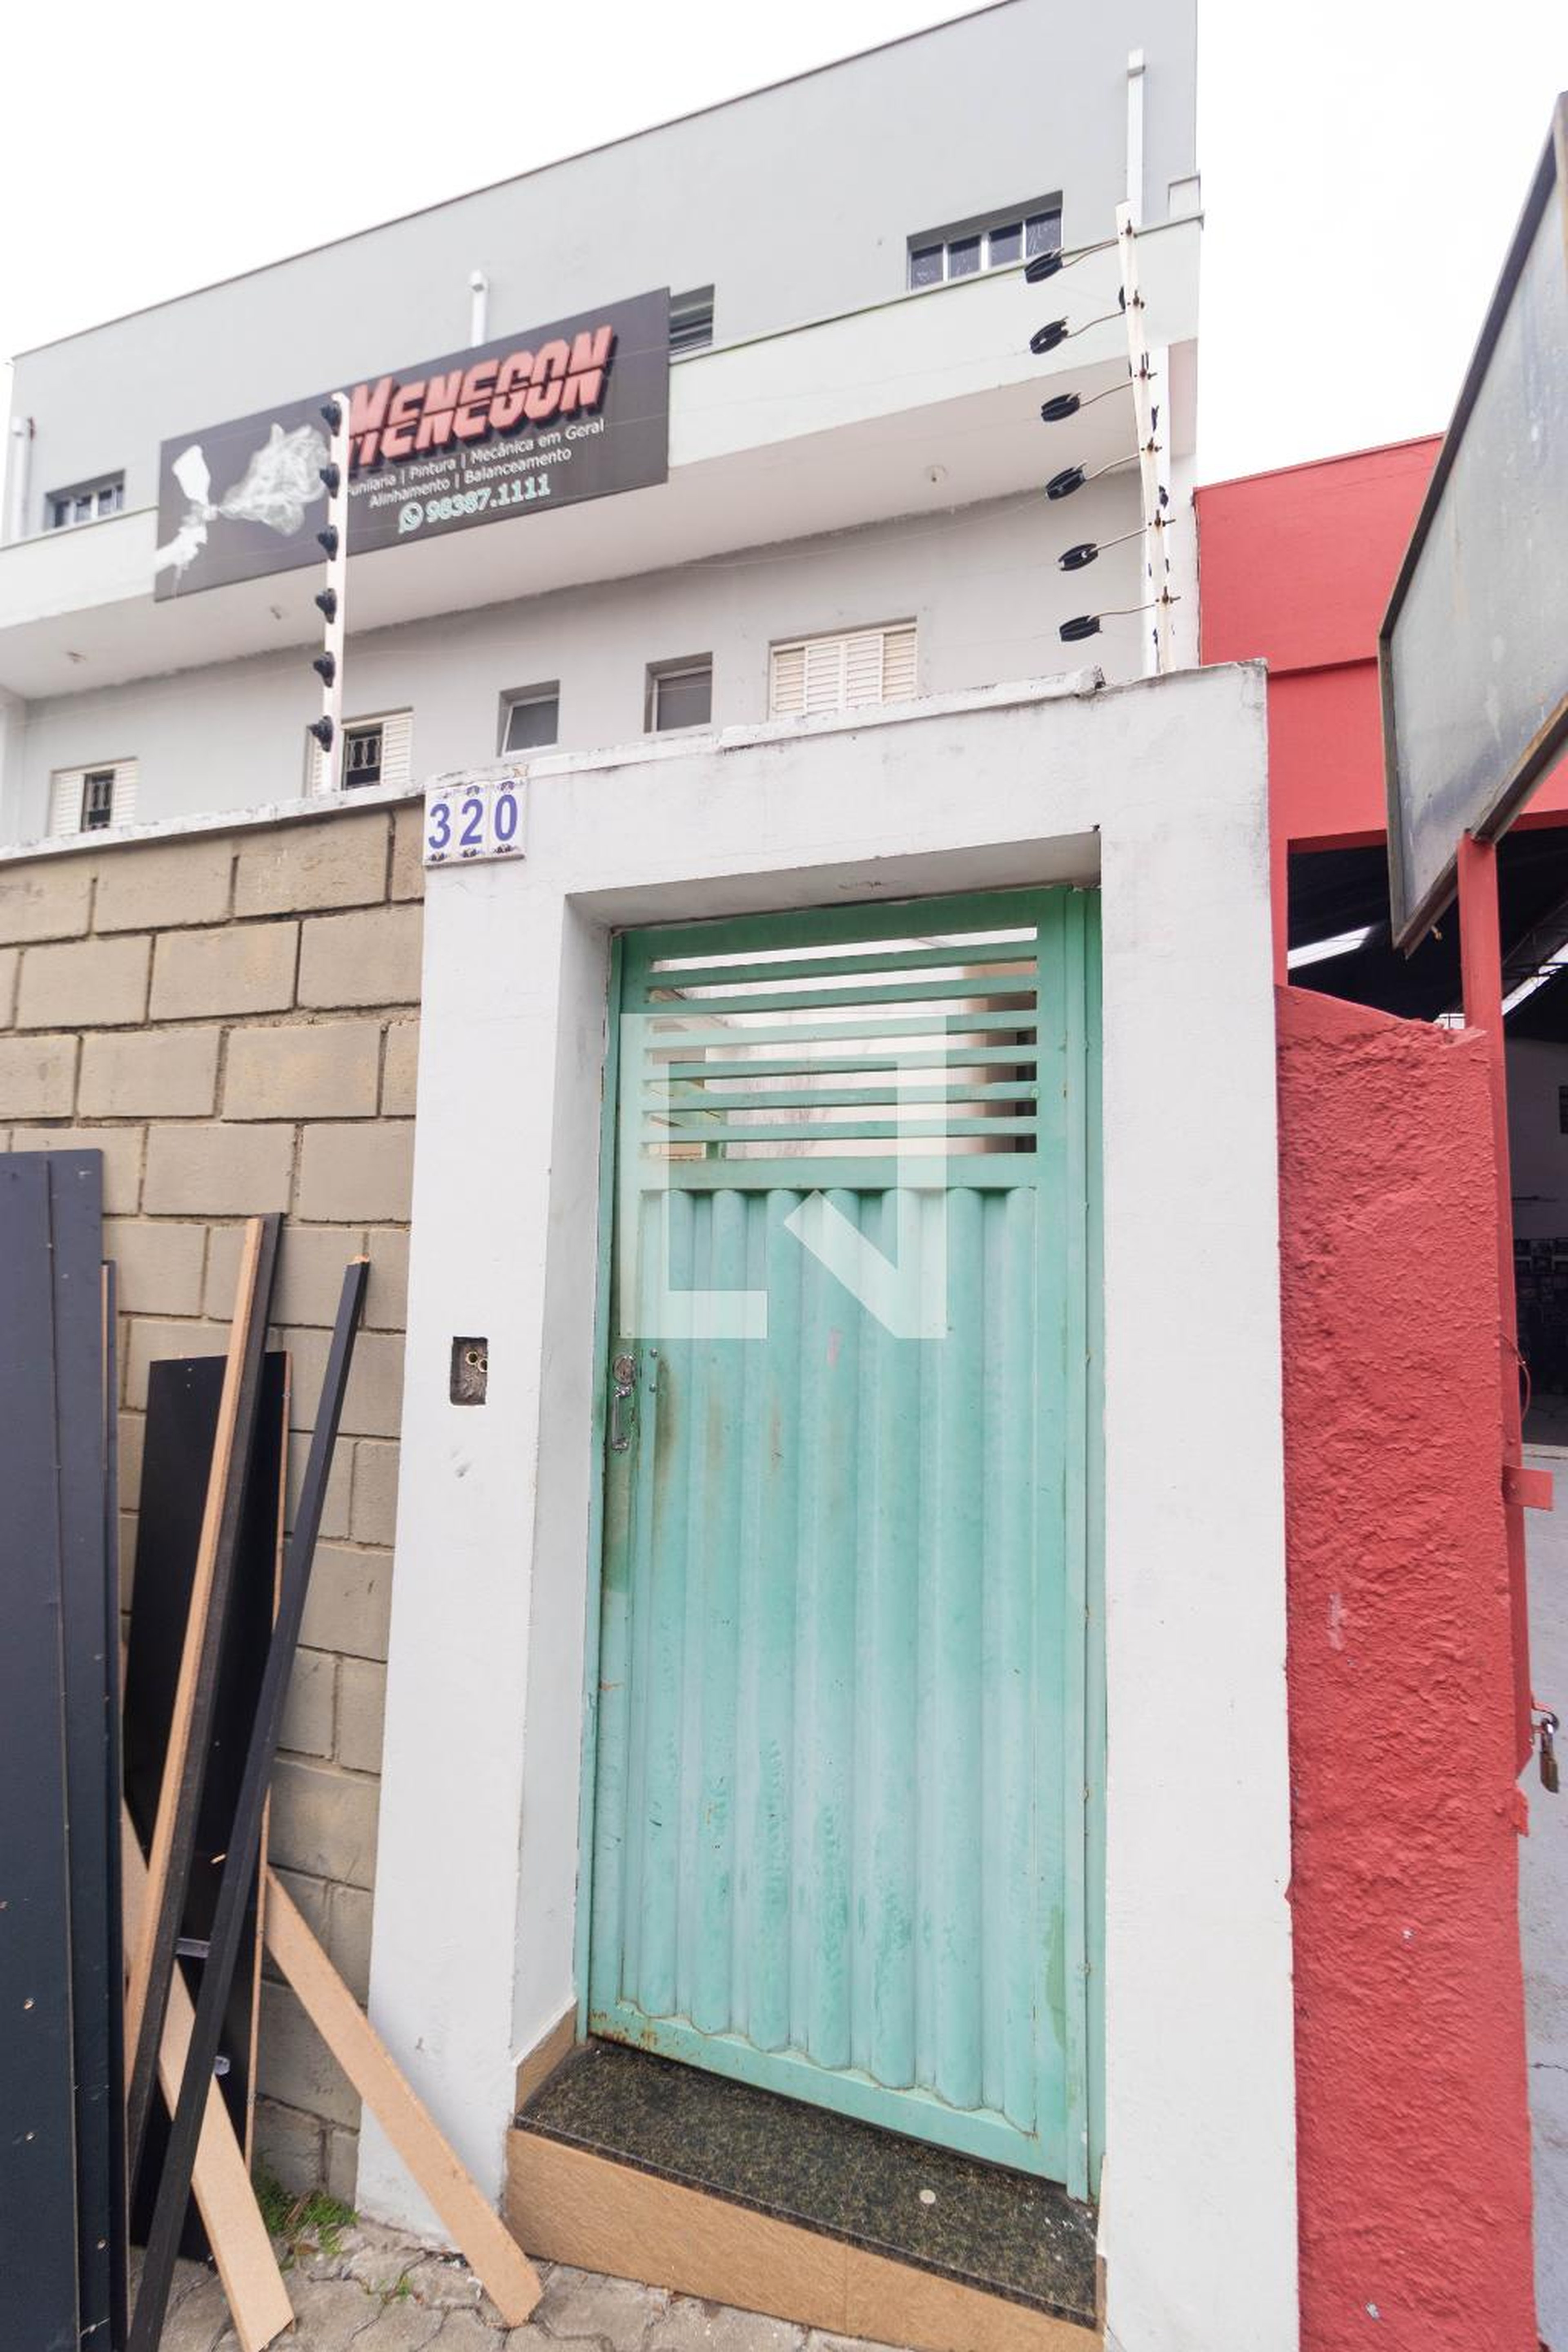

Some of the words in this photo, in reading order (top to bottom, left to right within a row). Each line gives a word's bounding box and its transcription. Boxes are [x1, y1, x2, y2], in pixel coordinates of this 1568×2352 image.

[349, 325, 613, 467] MENECON
[369, 477, 450, 508] Alinhamento
[464, 448, 572, 485] Balanceamento
[409, 459, 457, 480] Pintura
[470, 439, 534, 464] Mecânica
[538, 433, 561, 448] em
[565, 418, 605, 440] Geral
[429, 794, 517, 849] 320
